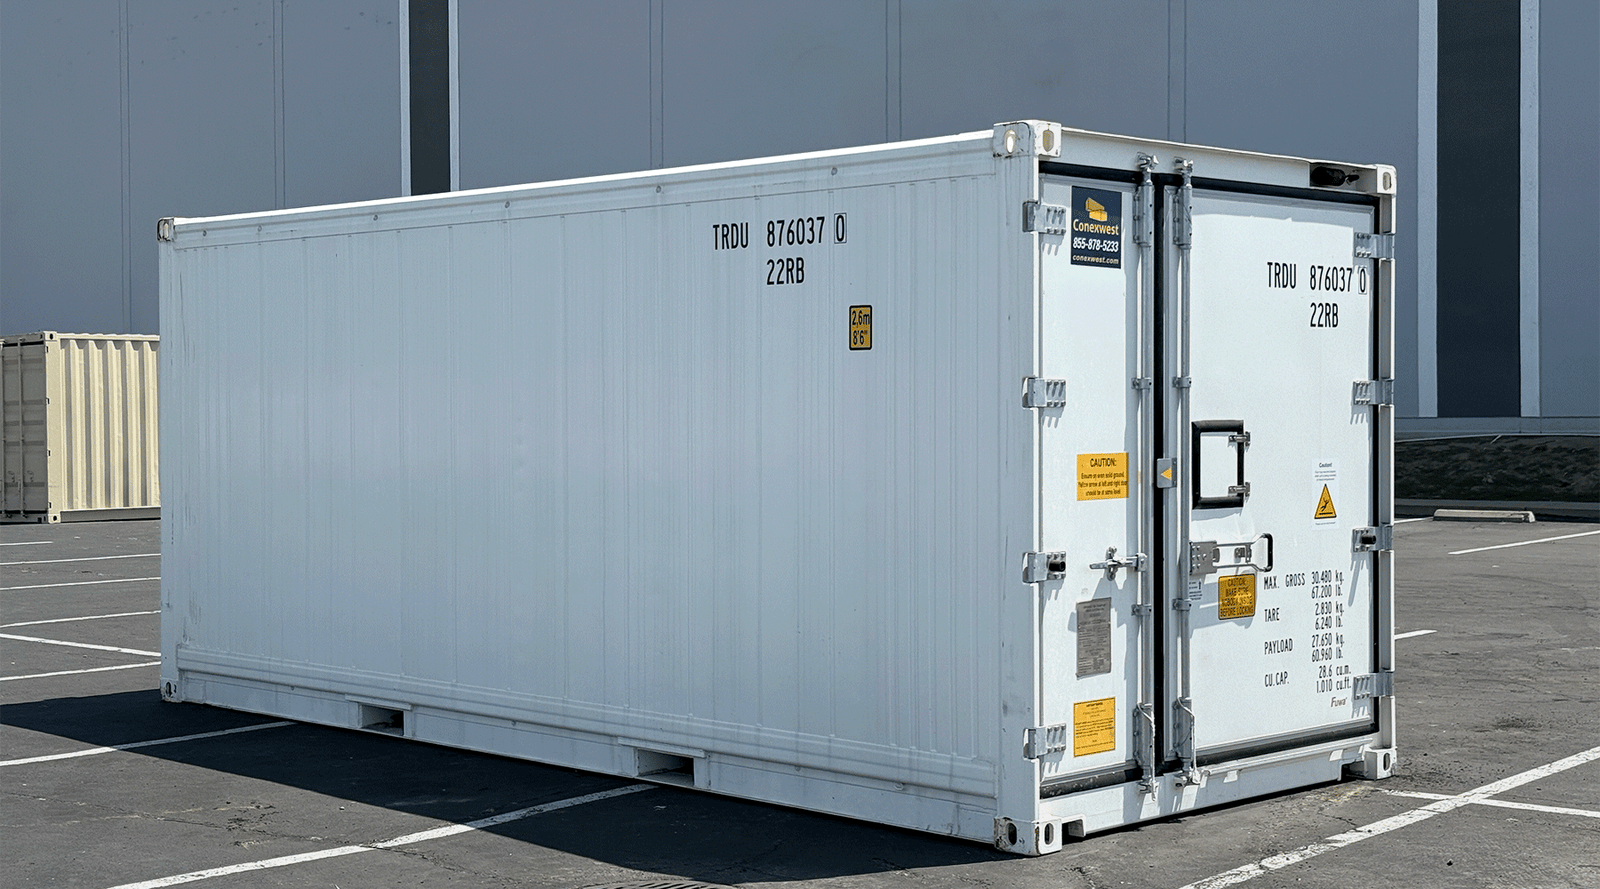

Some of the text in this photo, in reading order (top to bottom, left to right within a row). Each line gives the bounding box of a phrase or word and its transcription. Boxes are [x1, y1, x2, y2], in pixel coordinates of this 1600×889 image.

[713, 214, 845, 250] TRDU 876037 0
[1073, 219, 1119, 235] Conexwest
[1073, 237, 1119, 252] 855-878-5233
[1072, 254, 1119, 264] conexwest.com
[766, 257, 805, 285] 22RB
[1267, 262, 1366, 293] TRDU 876037 0
[1310, 302, 1339, 328] 22RB
[1263, 569, 1345, 590] MAX. GROSS 30.480 kg.
[1311, 583, 1343, 599] 67.200 lb.
[1264, 600, 1345, 622] TARE 2.830 kg.
[1314, 615, 1344, 630] 6.240 lb.
[1264, 631, 1345, 655] PAYLOAD 27.650 kg.
[1311, 646, 1344, 663] 60.960 lb.
[1264, 664, 1352, 687] CU.CAP. 28.6 cu.m.
[1316, 676, 1352, 694] 1.010 cu.ft.
